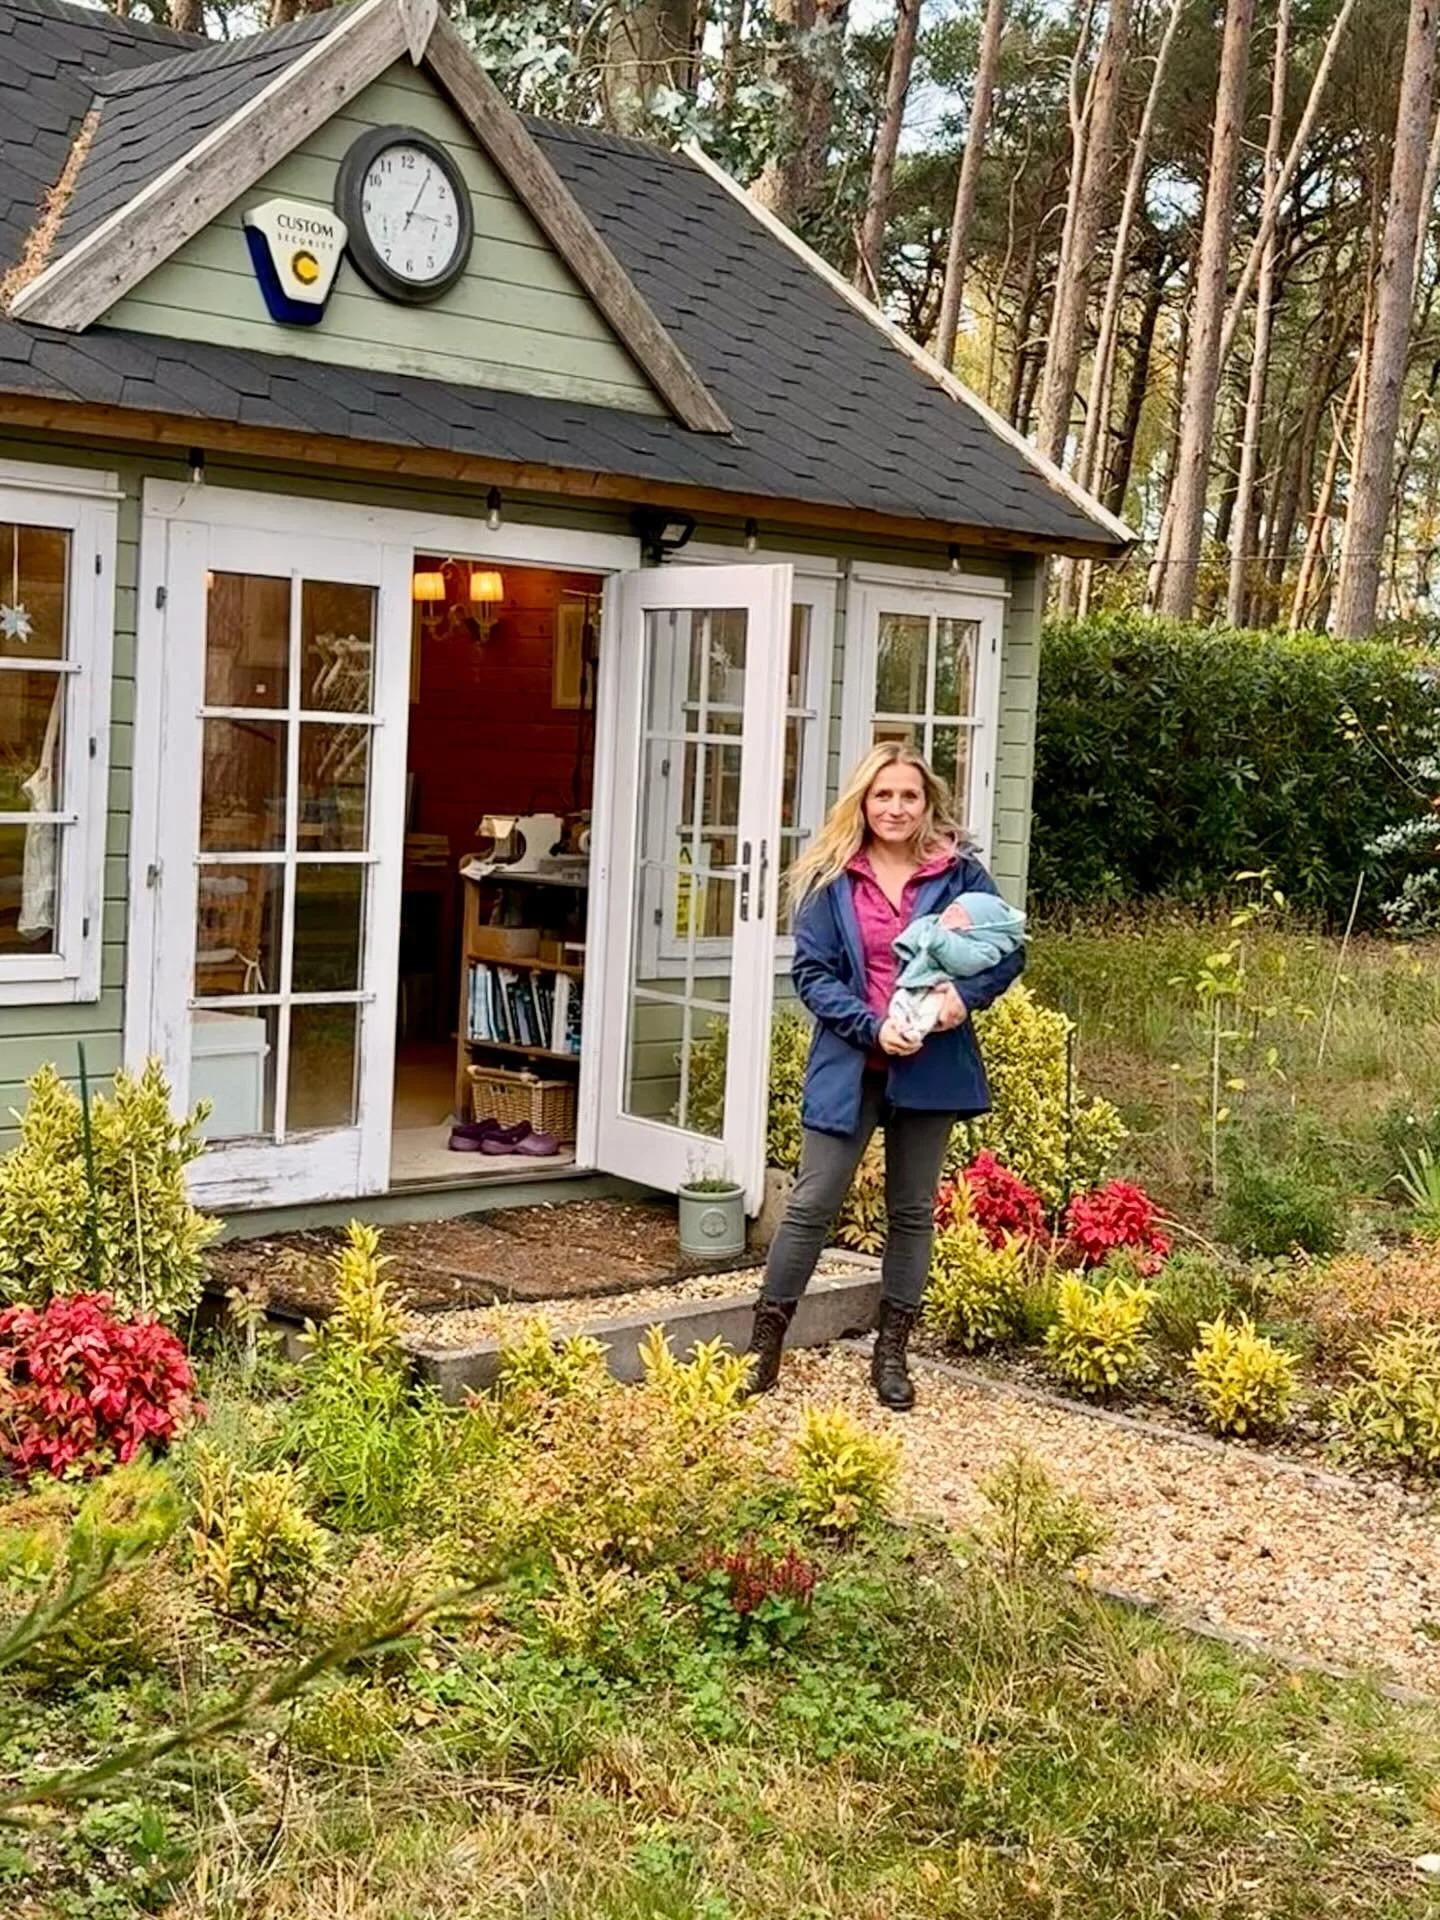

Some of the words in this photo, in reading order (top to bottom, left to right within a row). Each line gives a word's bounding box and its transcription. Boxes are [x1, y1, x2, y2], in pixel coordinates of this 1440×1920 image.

[380, 159, 392, 174] 11
[401, 155, 415, 169] 12
[369, 173, 382, 187] 10
[438, 185, 446, 199] 2
[363, 200, 372, 213] 9
[278, 214, 334, 238] CUSTOM
[444, 214, 453, 228] 3
[384, 248, 392, 262] 7
[426, 255, 434, 269] 5
[406, 259, 414, 273] 6
